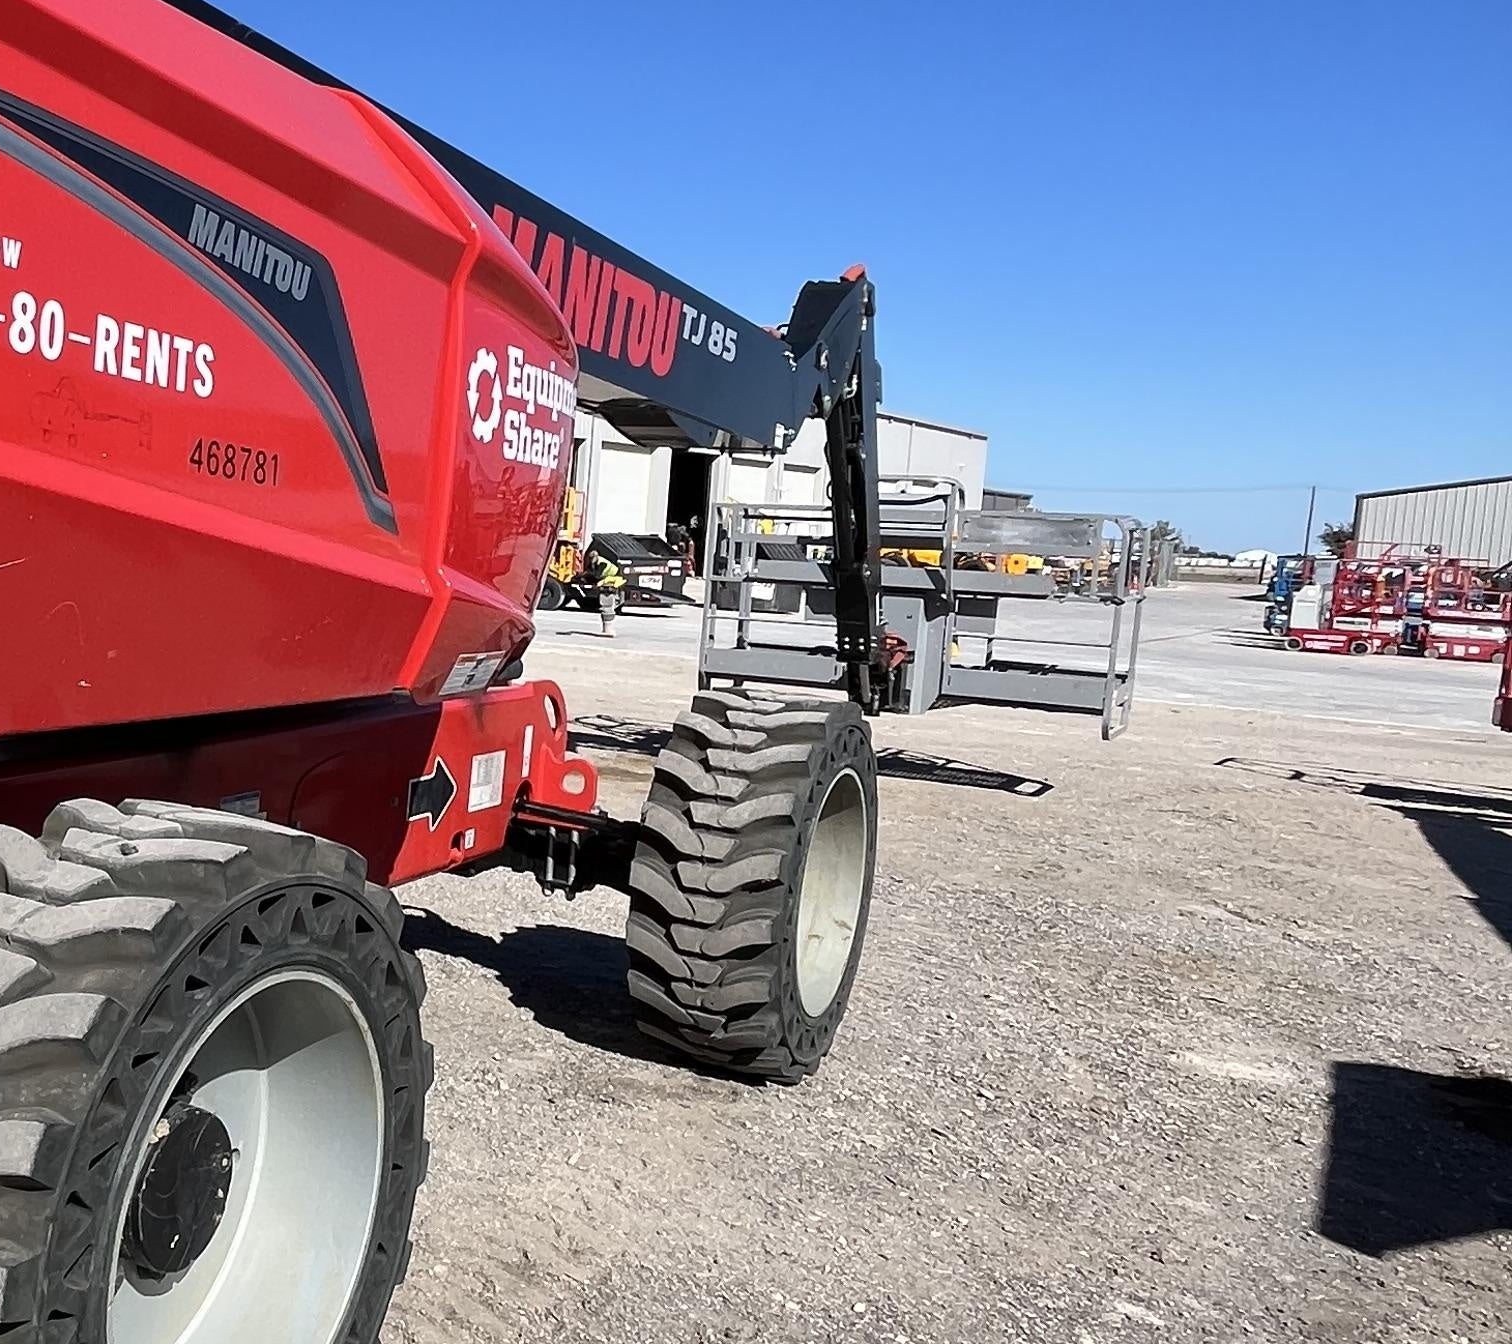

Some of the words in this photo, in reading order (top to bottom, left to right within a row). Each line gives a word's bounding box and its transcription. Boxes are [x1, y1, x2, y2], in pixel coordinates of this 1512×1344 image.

[188, 203, 312, 301] MANITOU
[682, 303, 707, 346] TJ
[708, 320, 738, 362] 85
[189, 437, 279, 487] 468781
[502, 408, 561, 469] Share
